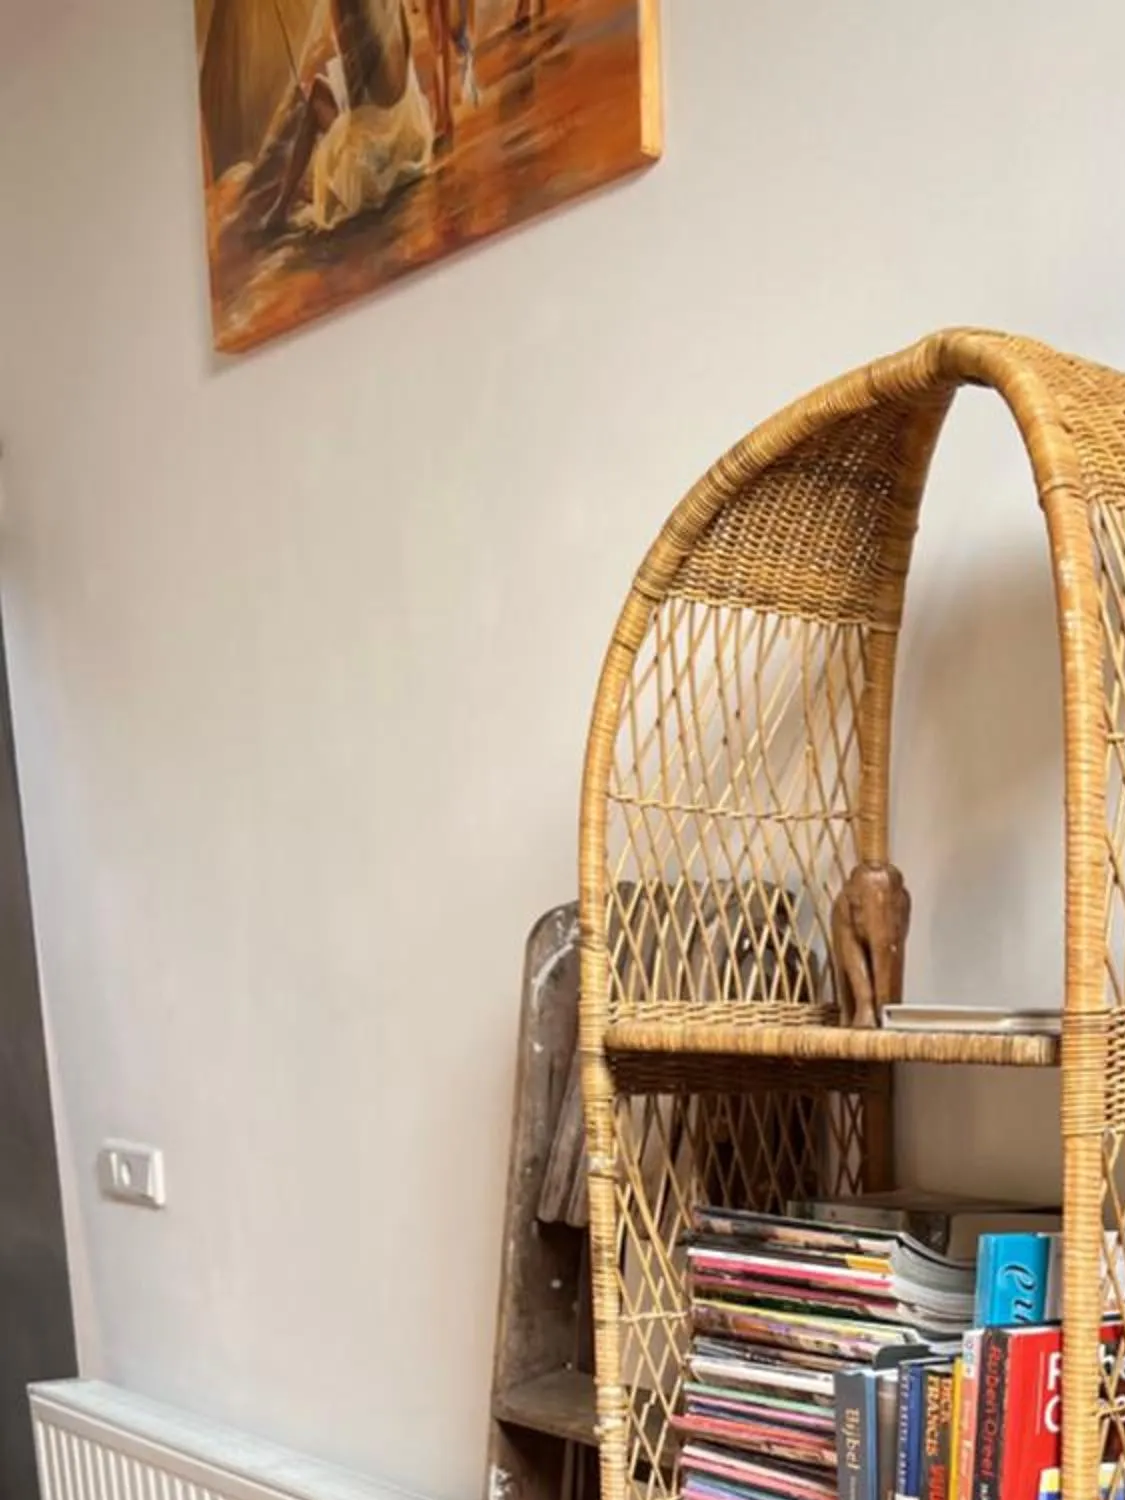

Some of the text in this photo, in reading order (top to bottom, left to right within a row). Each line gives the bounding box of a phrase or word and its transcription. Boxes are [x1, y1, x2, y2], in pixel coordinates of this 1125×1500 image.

[926, 1373, 941, 1457] FRANCIS
[940, 1377, 953, 1424] DICK
[979, 1343, 1001, 1477] Ruben Oreel
[842, 1407, 861, 1470] Bijbel
